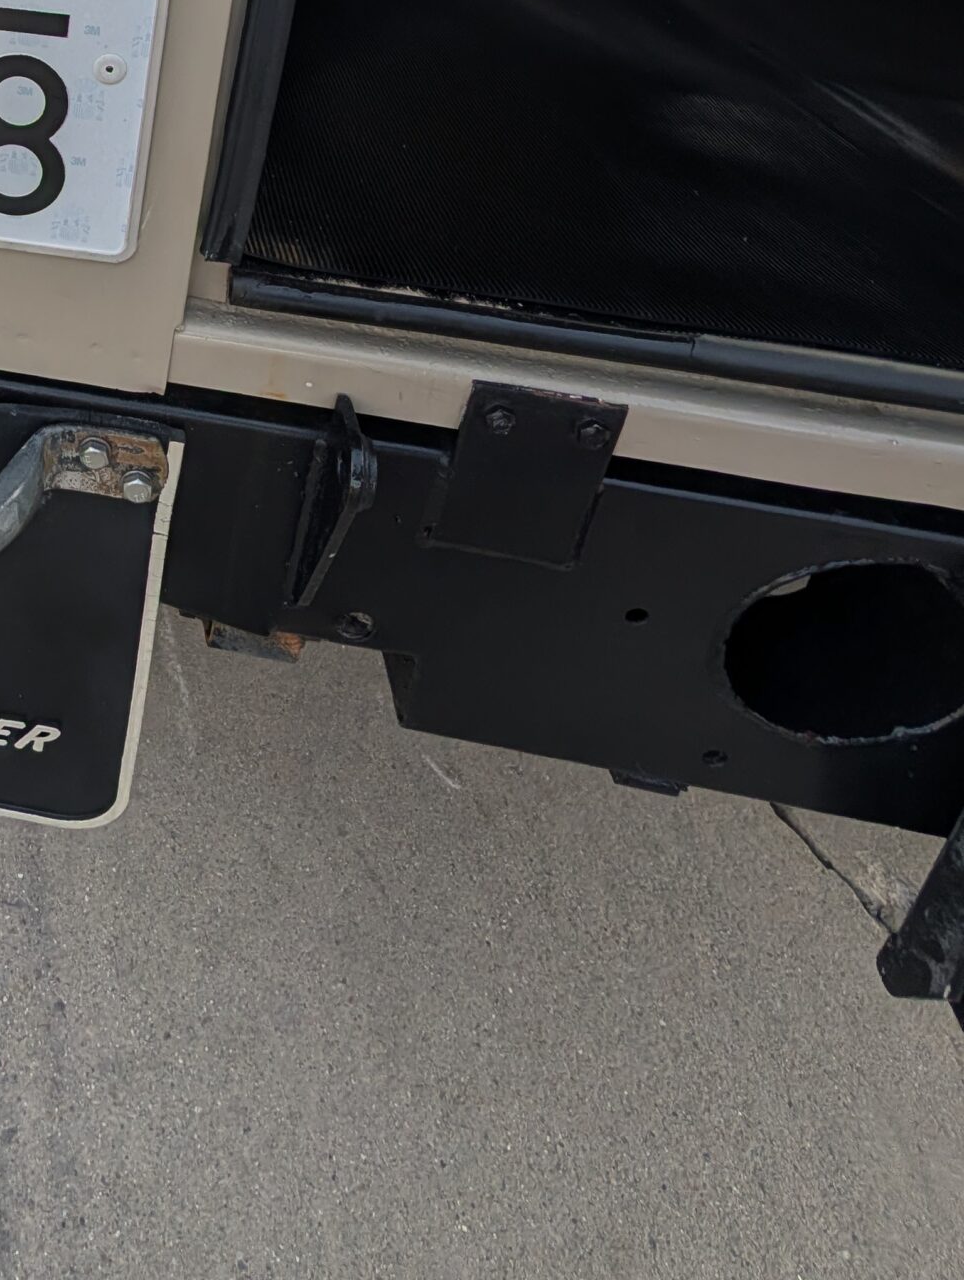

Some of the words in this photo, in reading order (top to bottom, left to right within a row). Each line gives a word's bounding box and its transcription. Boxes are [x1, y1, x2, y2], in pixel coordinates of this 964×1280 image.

[84, 25, 100, 36] 3M
[17, 86, 33, 96] 3M
[70, 157, 86, 166] 3M
